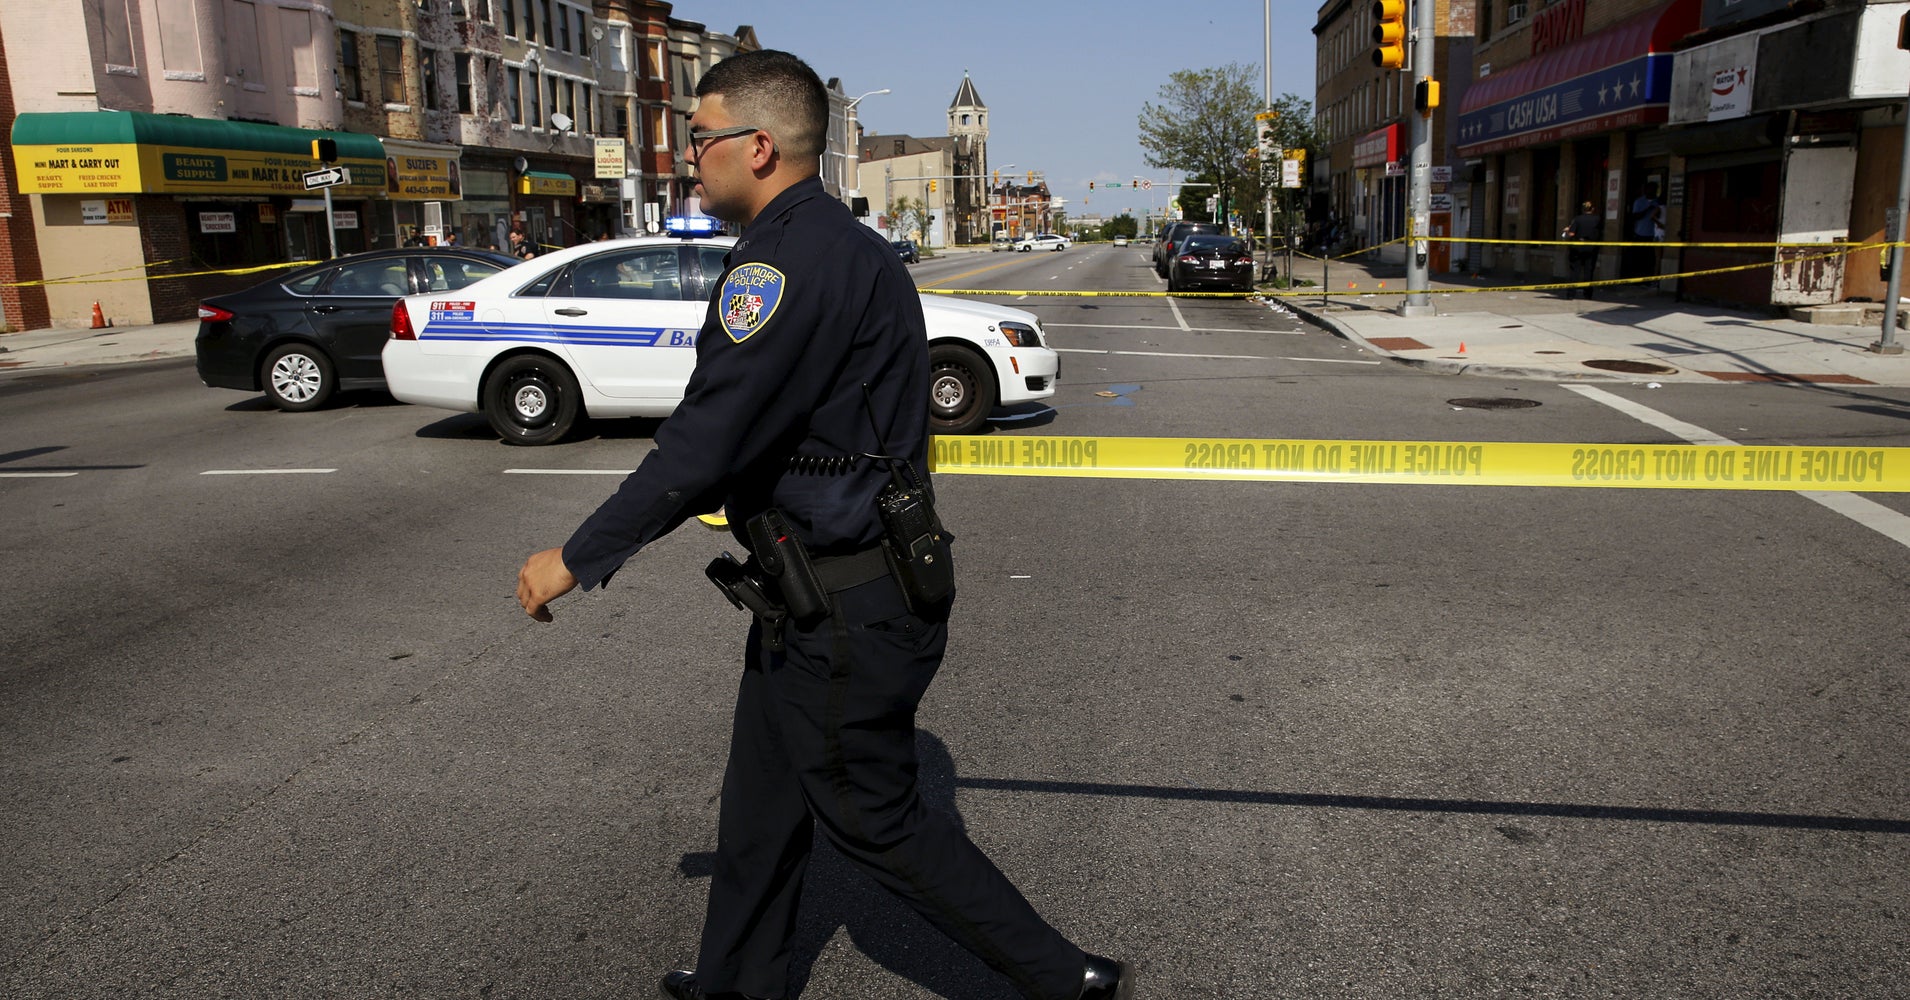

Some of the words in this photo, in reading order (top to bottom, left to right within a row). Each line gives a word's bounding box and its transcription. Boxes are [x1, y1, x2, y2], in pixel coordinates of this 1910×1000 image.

[1532, 0, 1586, 57] PAWN
[1716, 75, 1735, 85] MAYOR
[1507, 99, 1535, 132] CASH
[1535, 93, 1558, 125] USA
[48, 159, 69, 169] MART
[71, 159, 77, 169] &
[79, 159, 102, 169] CARRY
[104, 159, 120, 169] OUT
[175, 157, 216, 168] BEAUTY
[407, 159, 438, 170] SUZIE'S
[176, 169, 216, 179] SUPPLY
[232, 169, 250, 180] MINI
[252, 167, 279, 182] MART
[281, 169, 290, 183] &
[321, 174, 331, 182] WAY
[107, 200, 132, 214] ATM
[260, 204, 273, 216] ATM
[729, 267, 780, 285] BALTIMORE
[734, 275, 767, 289] POLICE
[432, 302, 446, 310] 911
[431, 312, 445, 320] 311
